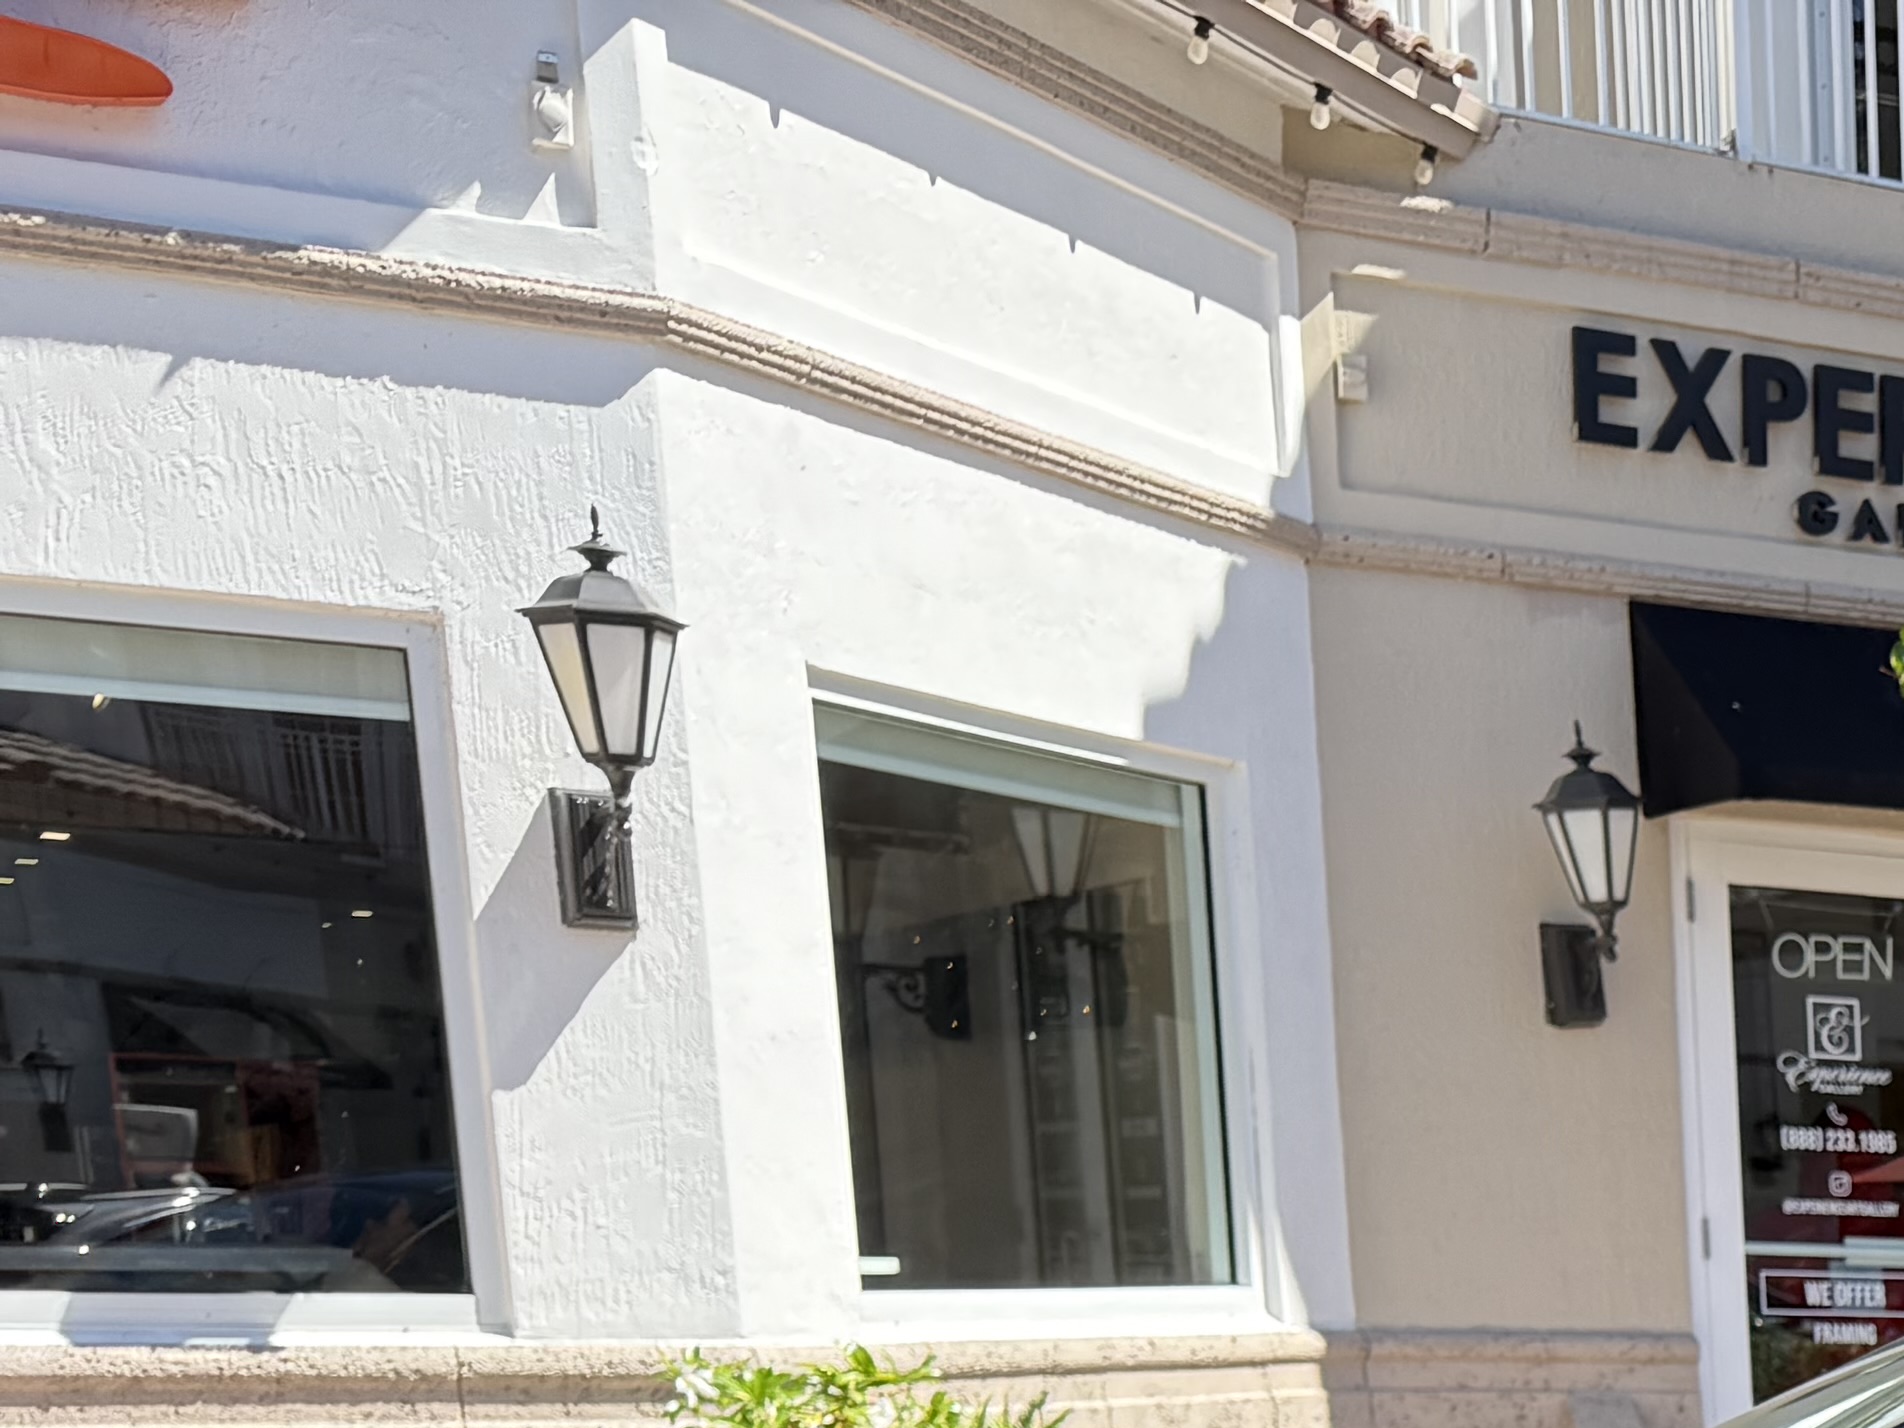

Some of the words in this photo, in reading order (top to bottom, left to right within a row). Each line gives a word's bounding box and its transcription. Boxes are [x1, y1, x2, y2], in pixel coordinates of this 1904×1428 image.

[1772, 932, 1893, 981] OPEN
[1803, 1280, 1832, 1307] WE
[1832, 1281, 1887, 1308] OFFER
[1812, 1321, 1879, 1346] FRAMING
